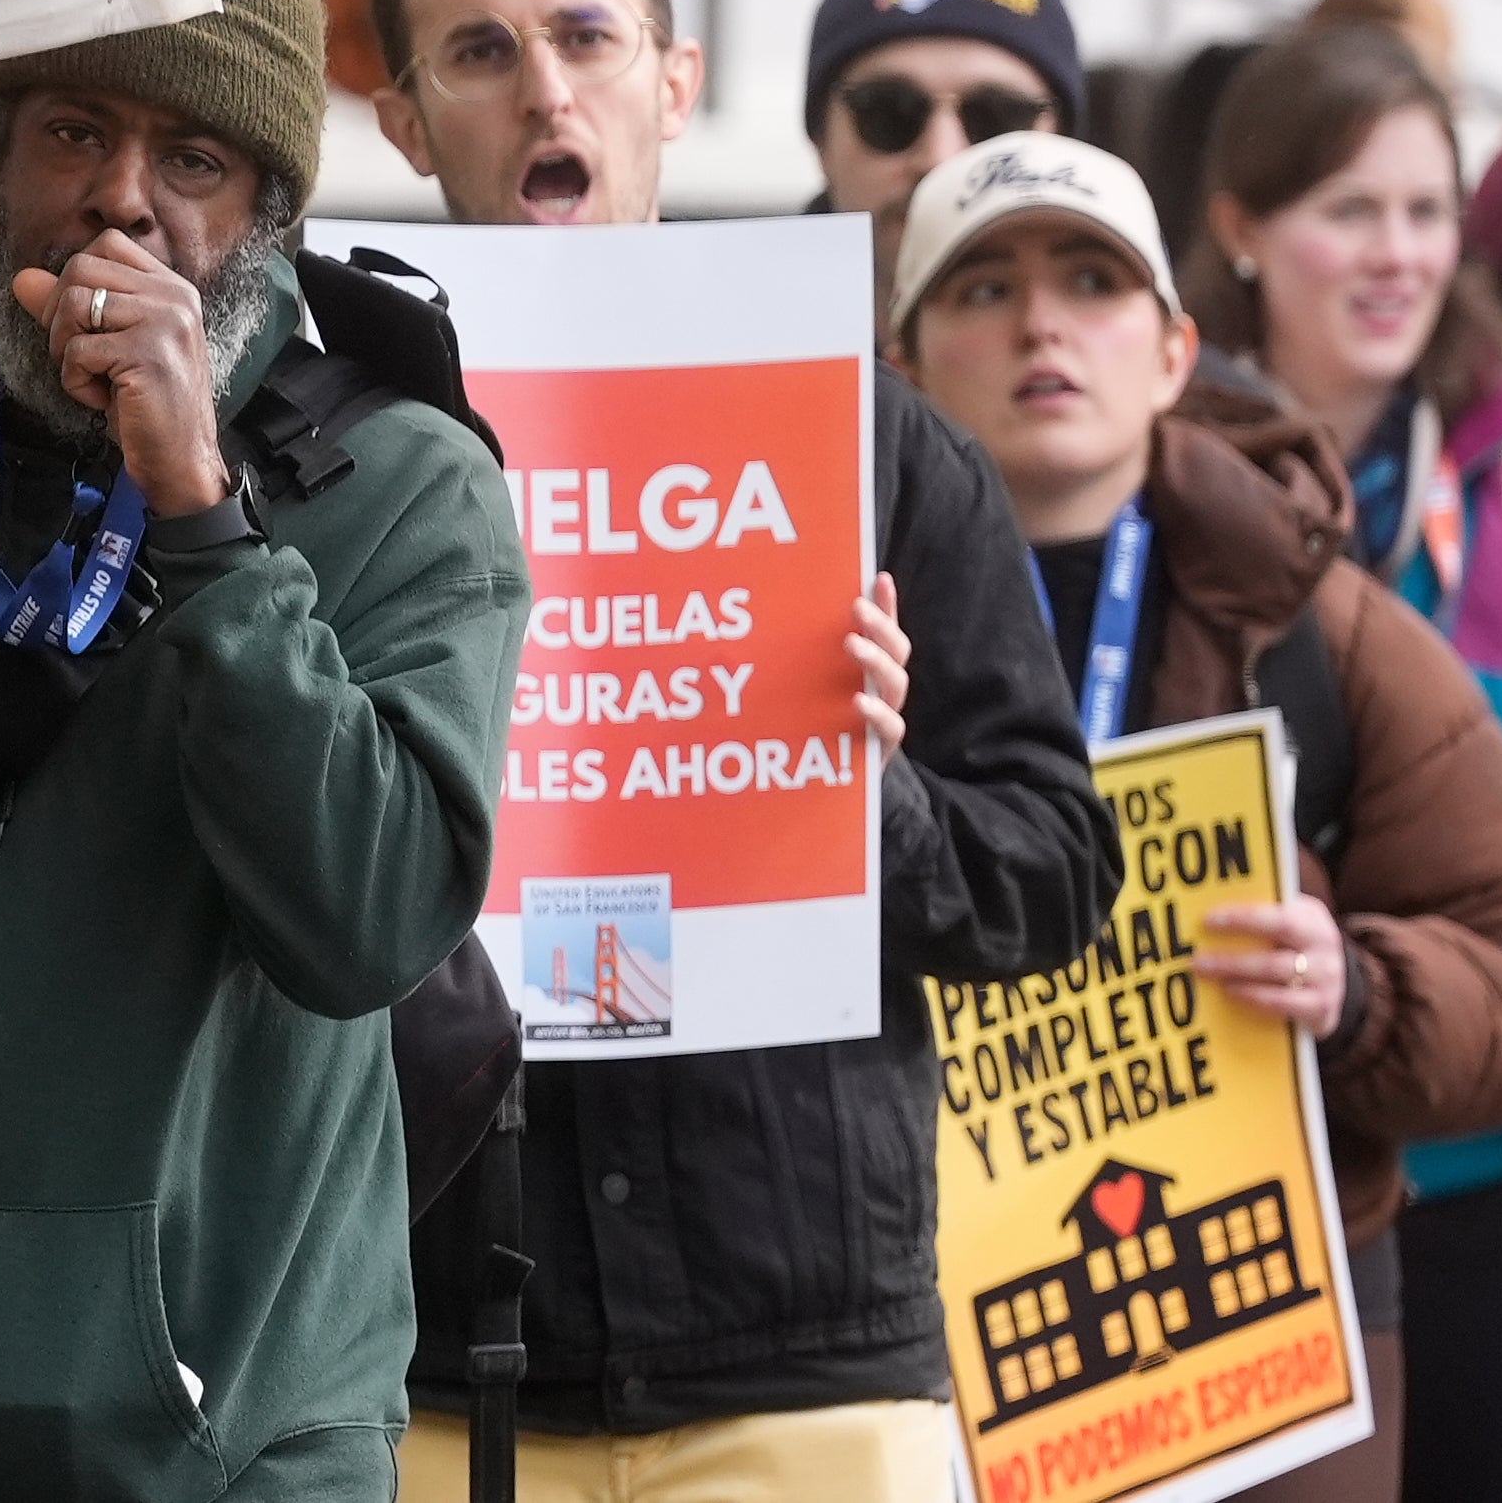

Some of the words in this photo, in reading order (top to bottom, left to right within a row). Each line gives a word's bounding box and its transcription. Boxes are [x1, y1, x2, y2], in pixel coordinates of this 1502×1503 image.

[89, 569, 112, 598] ON
[9, 595, 41, 639] STRIKE
[522, 587, 753, 649] CUELAS
[710, 663, 754, 717] Y
[499, 748, 608, 803] LES
[620, 732, 854, 800] AHORA!
[1106, 780, 1175, 827] OS
[1140, 816, 1251, 893] CON
[942, 971, 1195, 1115] COMPLETO
[966, 1119, 995, 1180] Y
[1013, 1035, 1216, 1164] ESTABLE
[985, 1455, 1030, 1503] NO
[1036, 1387, 1193, 1496] PODEMOS
[1196, 1332, 1334, 1430] ESPERAR
